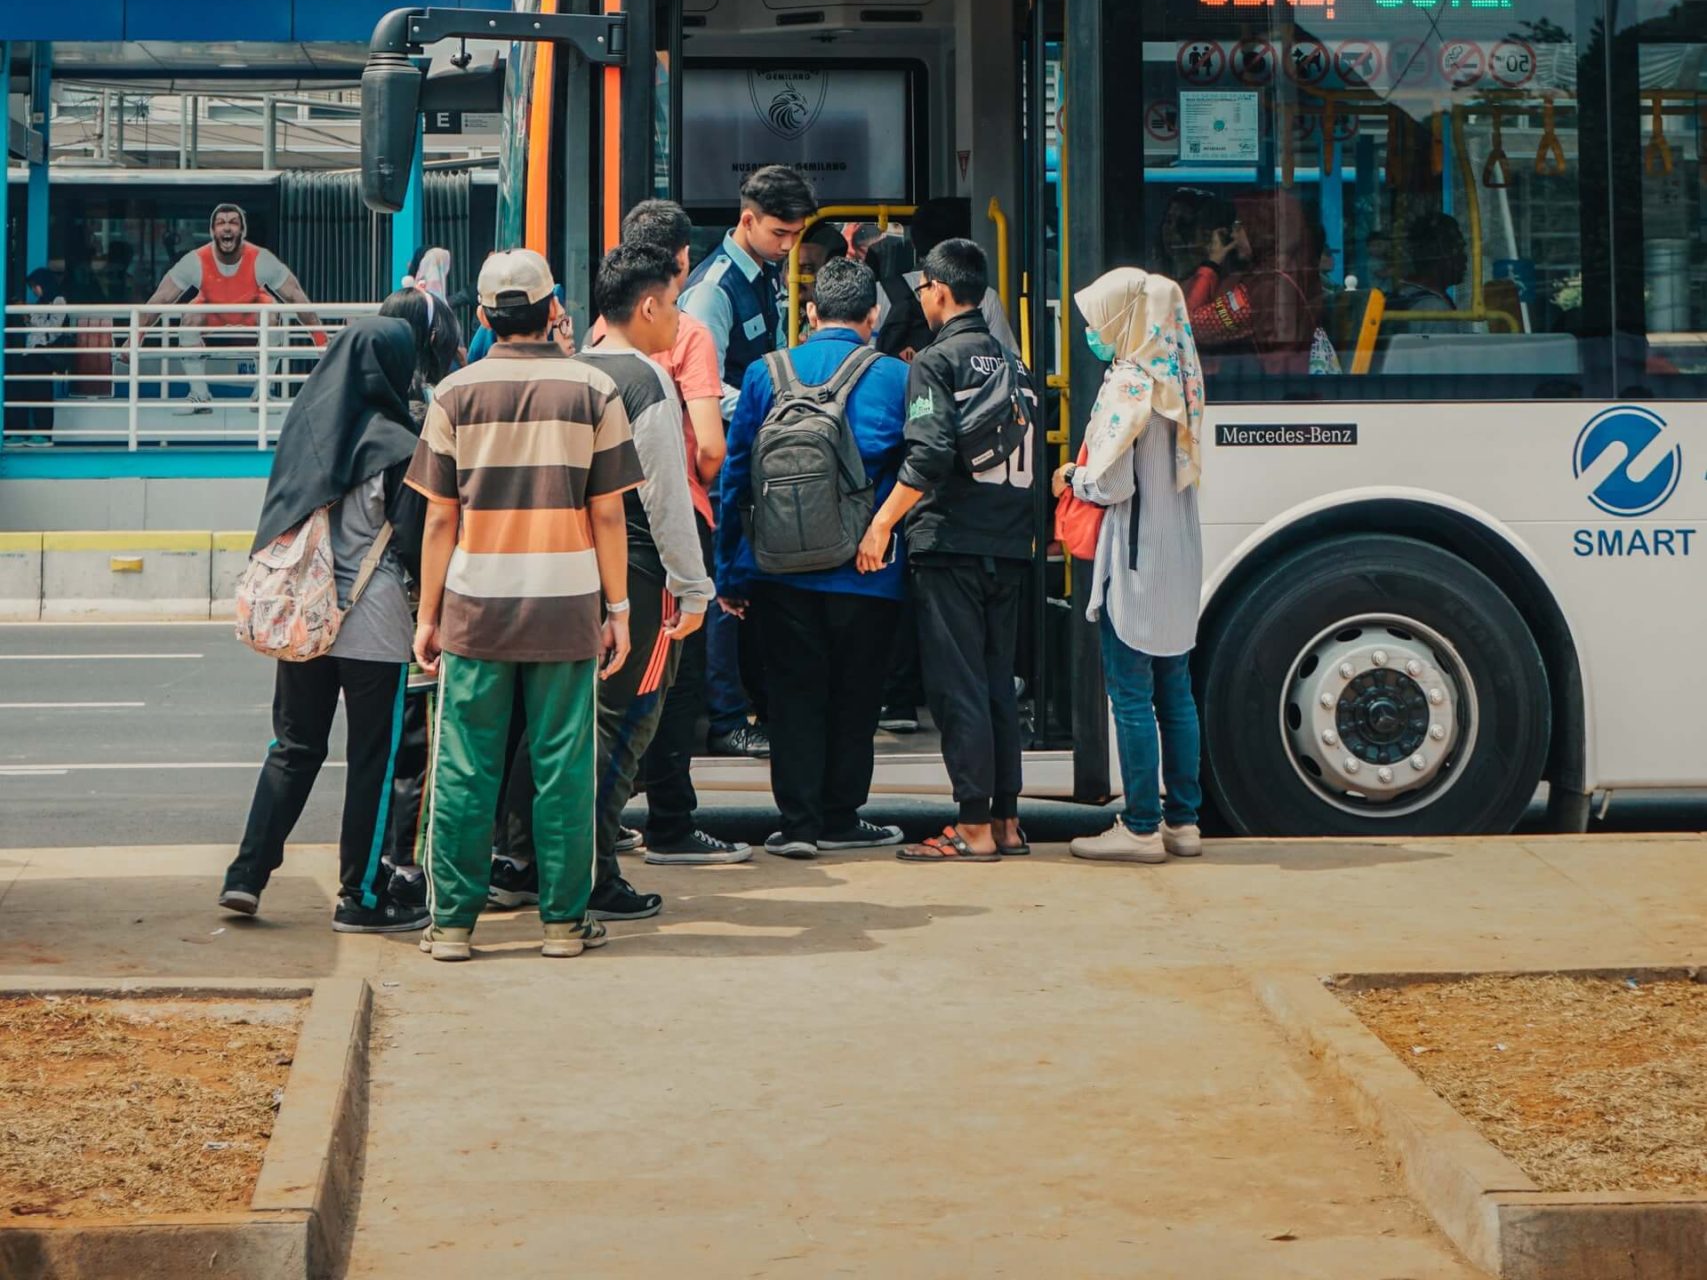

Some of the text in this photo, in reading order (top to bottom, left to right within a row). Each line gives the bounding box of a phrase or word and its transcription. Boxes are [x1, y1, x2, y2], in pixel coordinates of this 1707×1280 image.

[436, 112, 450, 127] E
[1222, 426, 1352, 444] Mercedes-Benz
[1573, 528, 1697, 557] SMART
